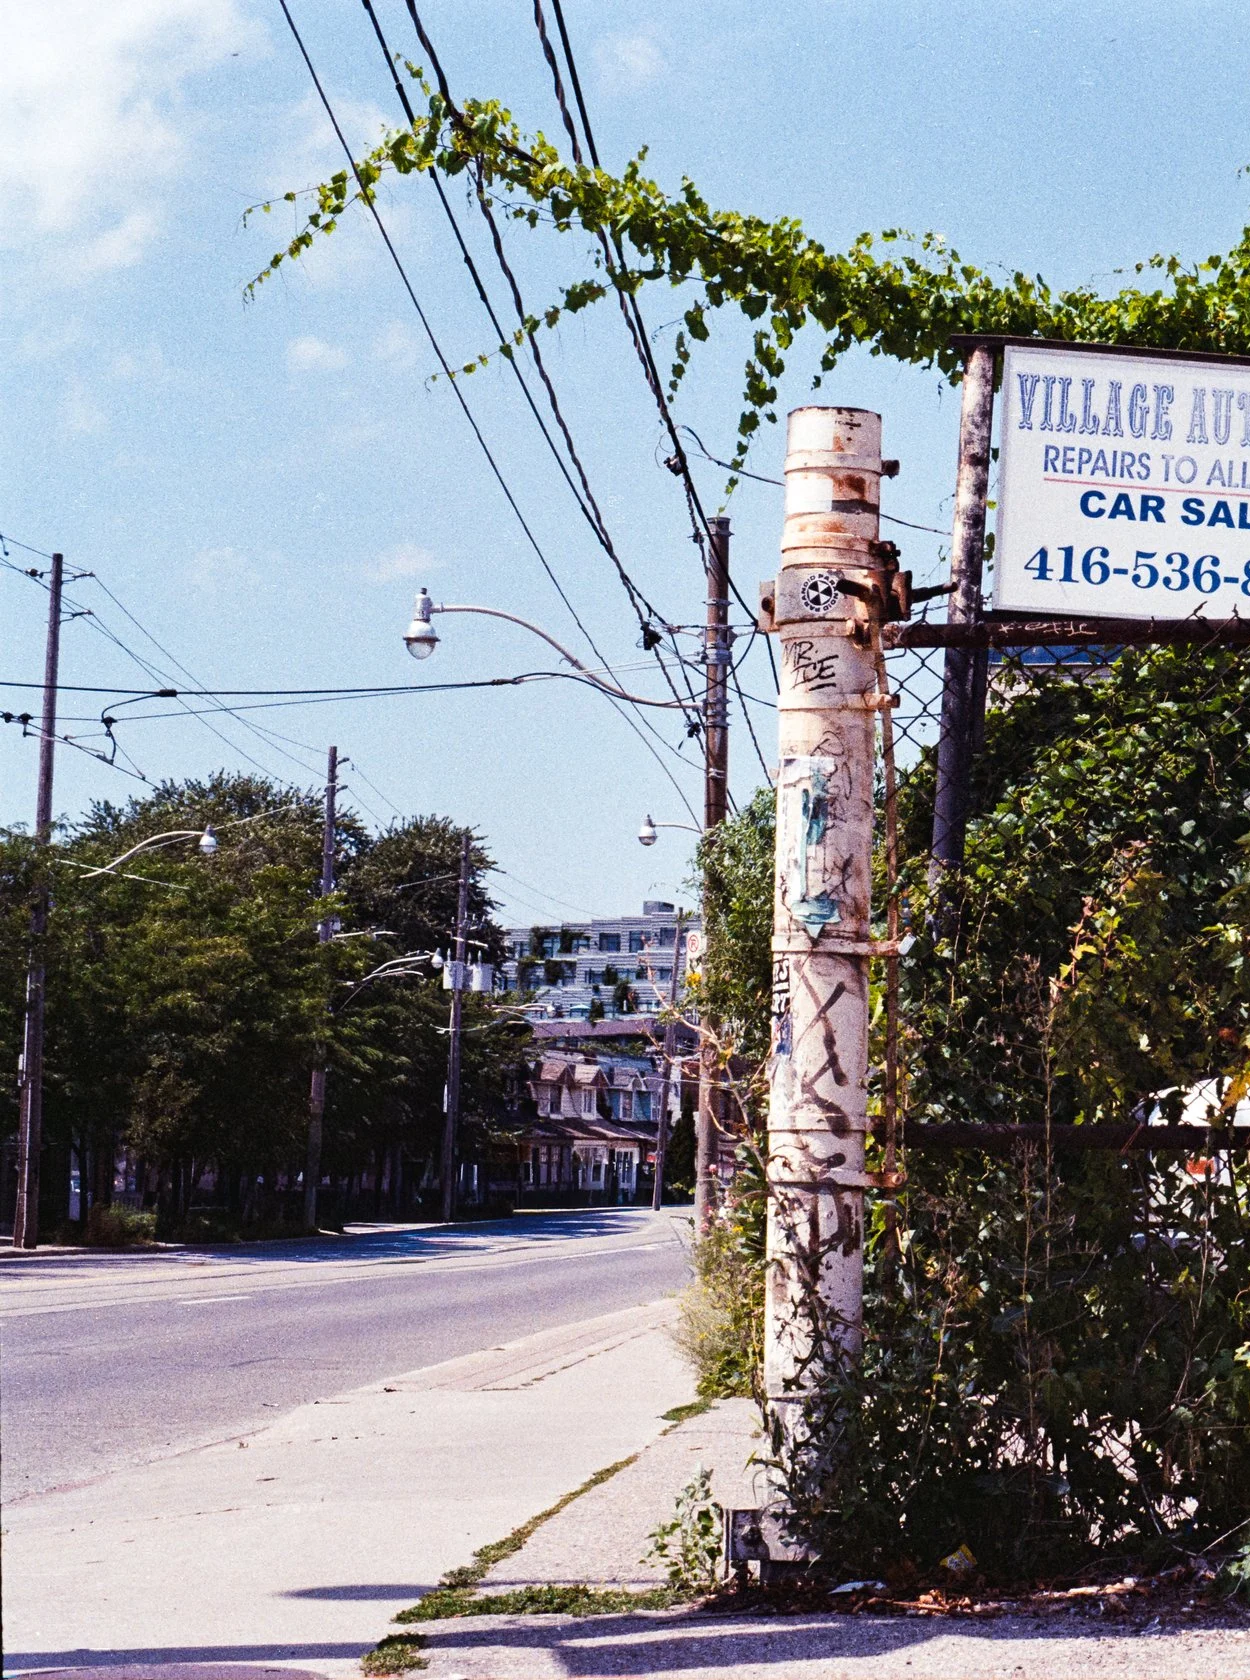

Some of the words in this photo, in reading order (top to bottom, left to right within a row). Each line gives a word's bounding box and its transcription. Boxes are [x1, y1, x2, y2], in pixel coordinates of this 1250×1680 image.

[1017, 374, 1174, 441] VILLAGE
[1044, 445, 1151, 480] REPAIRS
[1162, 454, 1196, 484] TO
[1080, 490, 1166, 523] CAR
